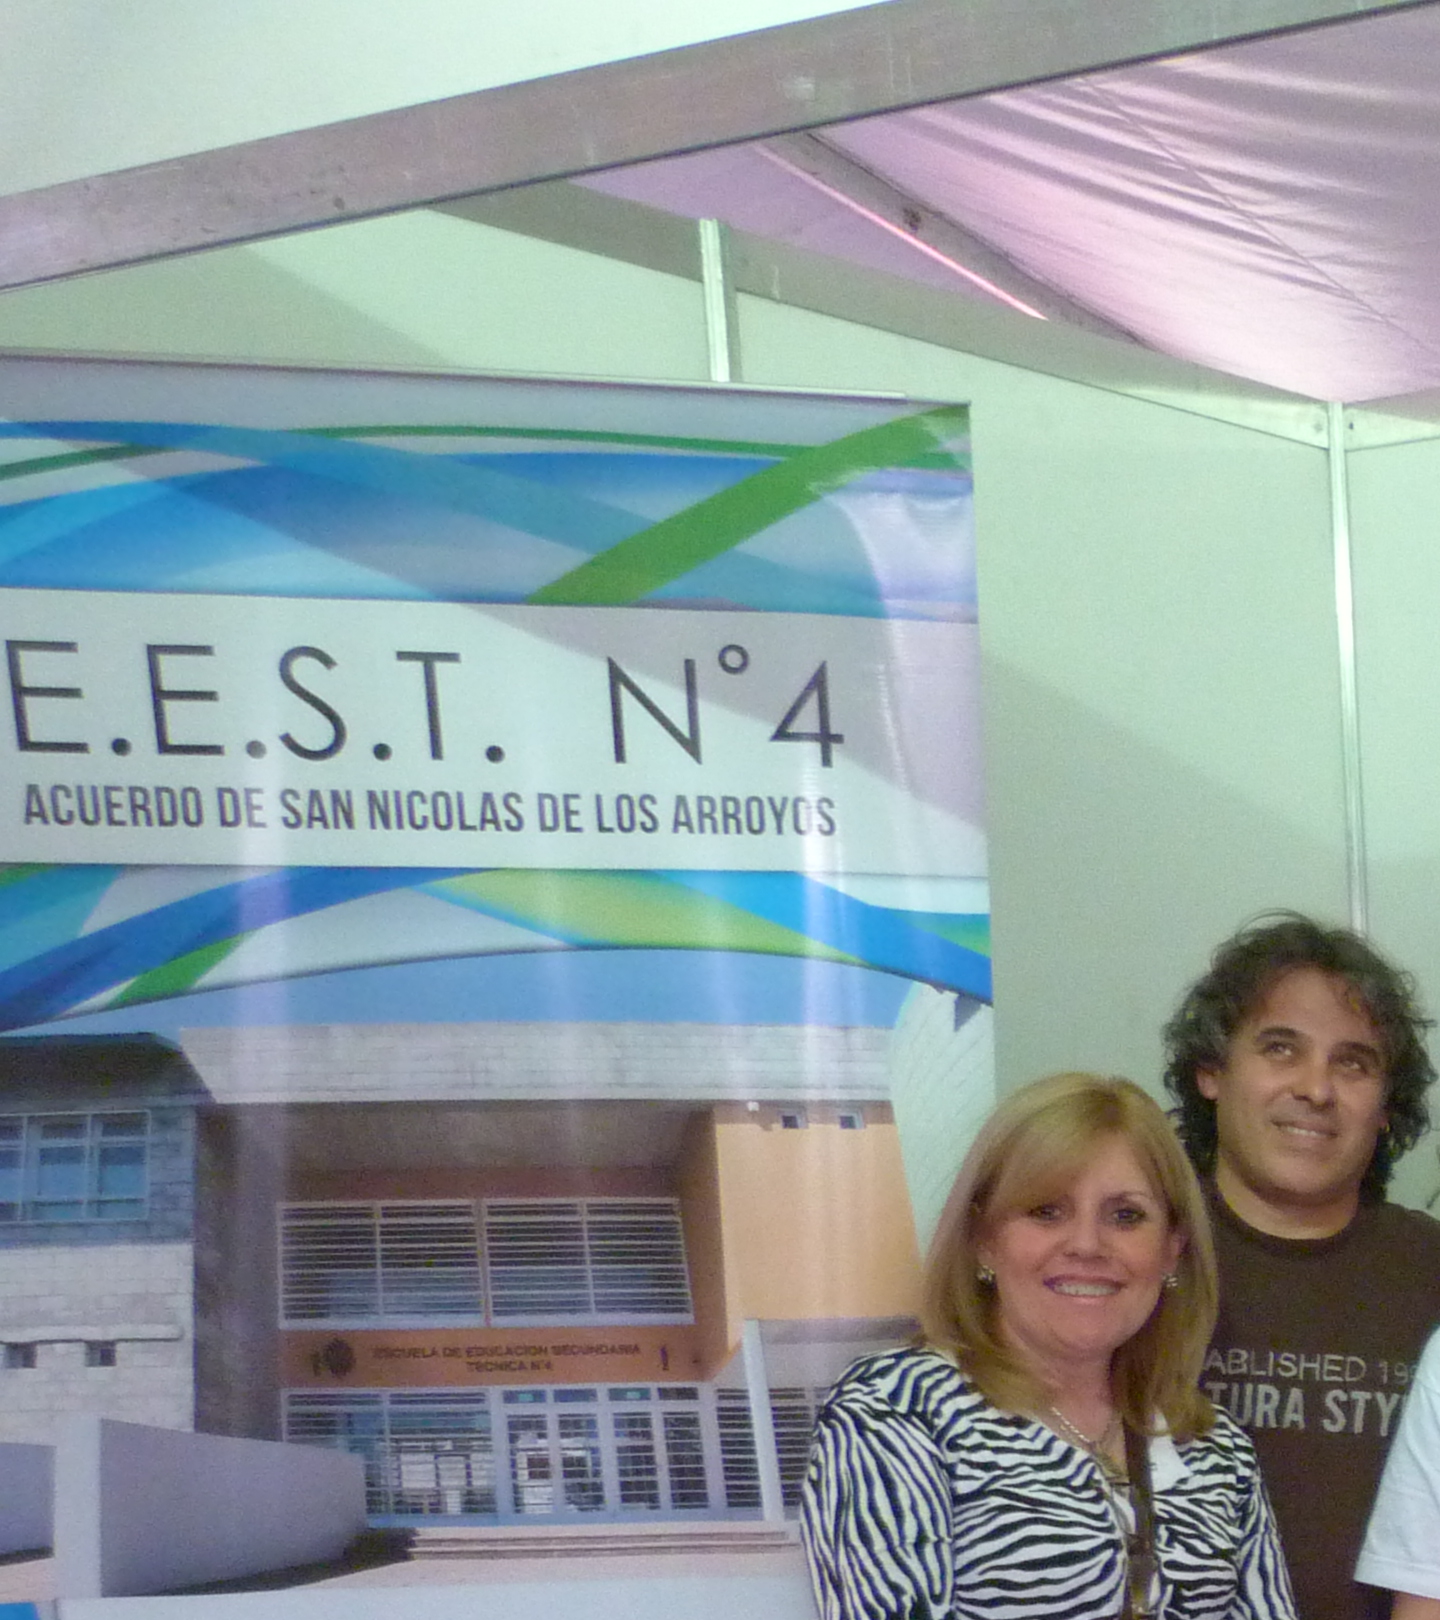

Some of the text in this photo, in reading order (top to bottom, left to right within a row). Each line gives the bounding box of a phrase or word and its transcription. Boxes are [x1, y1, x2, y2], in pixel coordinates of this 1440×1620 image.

[5, 638, 506, 764] E.E.S.T.
[22, 783, 838, 838] ACUERDO DE SAN NICOLAS DE LOS ARROYOS
[1204, 1348, 1367, 1382] ABLISHED
[1205, 1381, 1306, 1430] TURA
